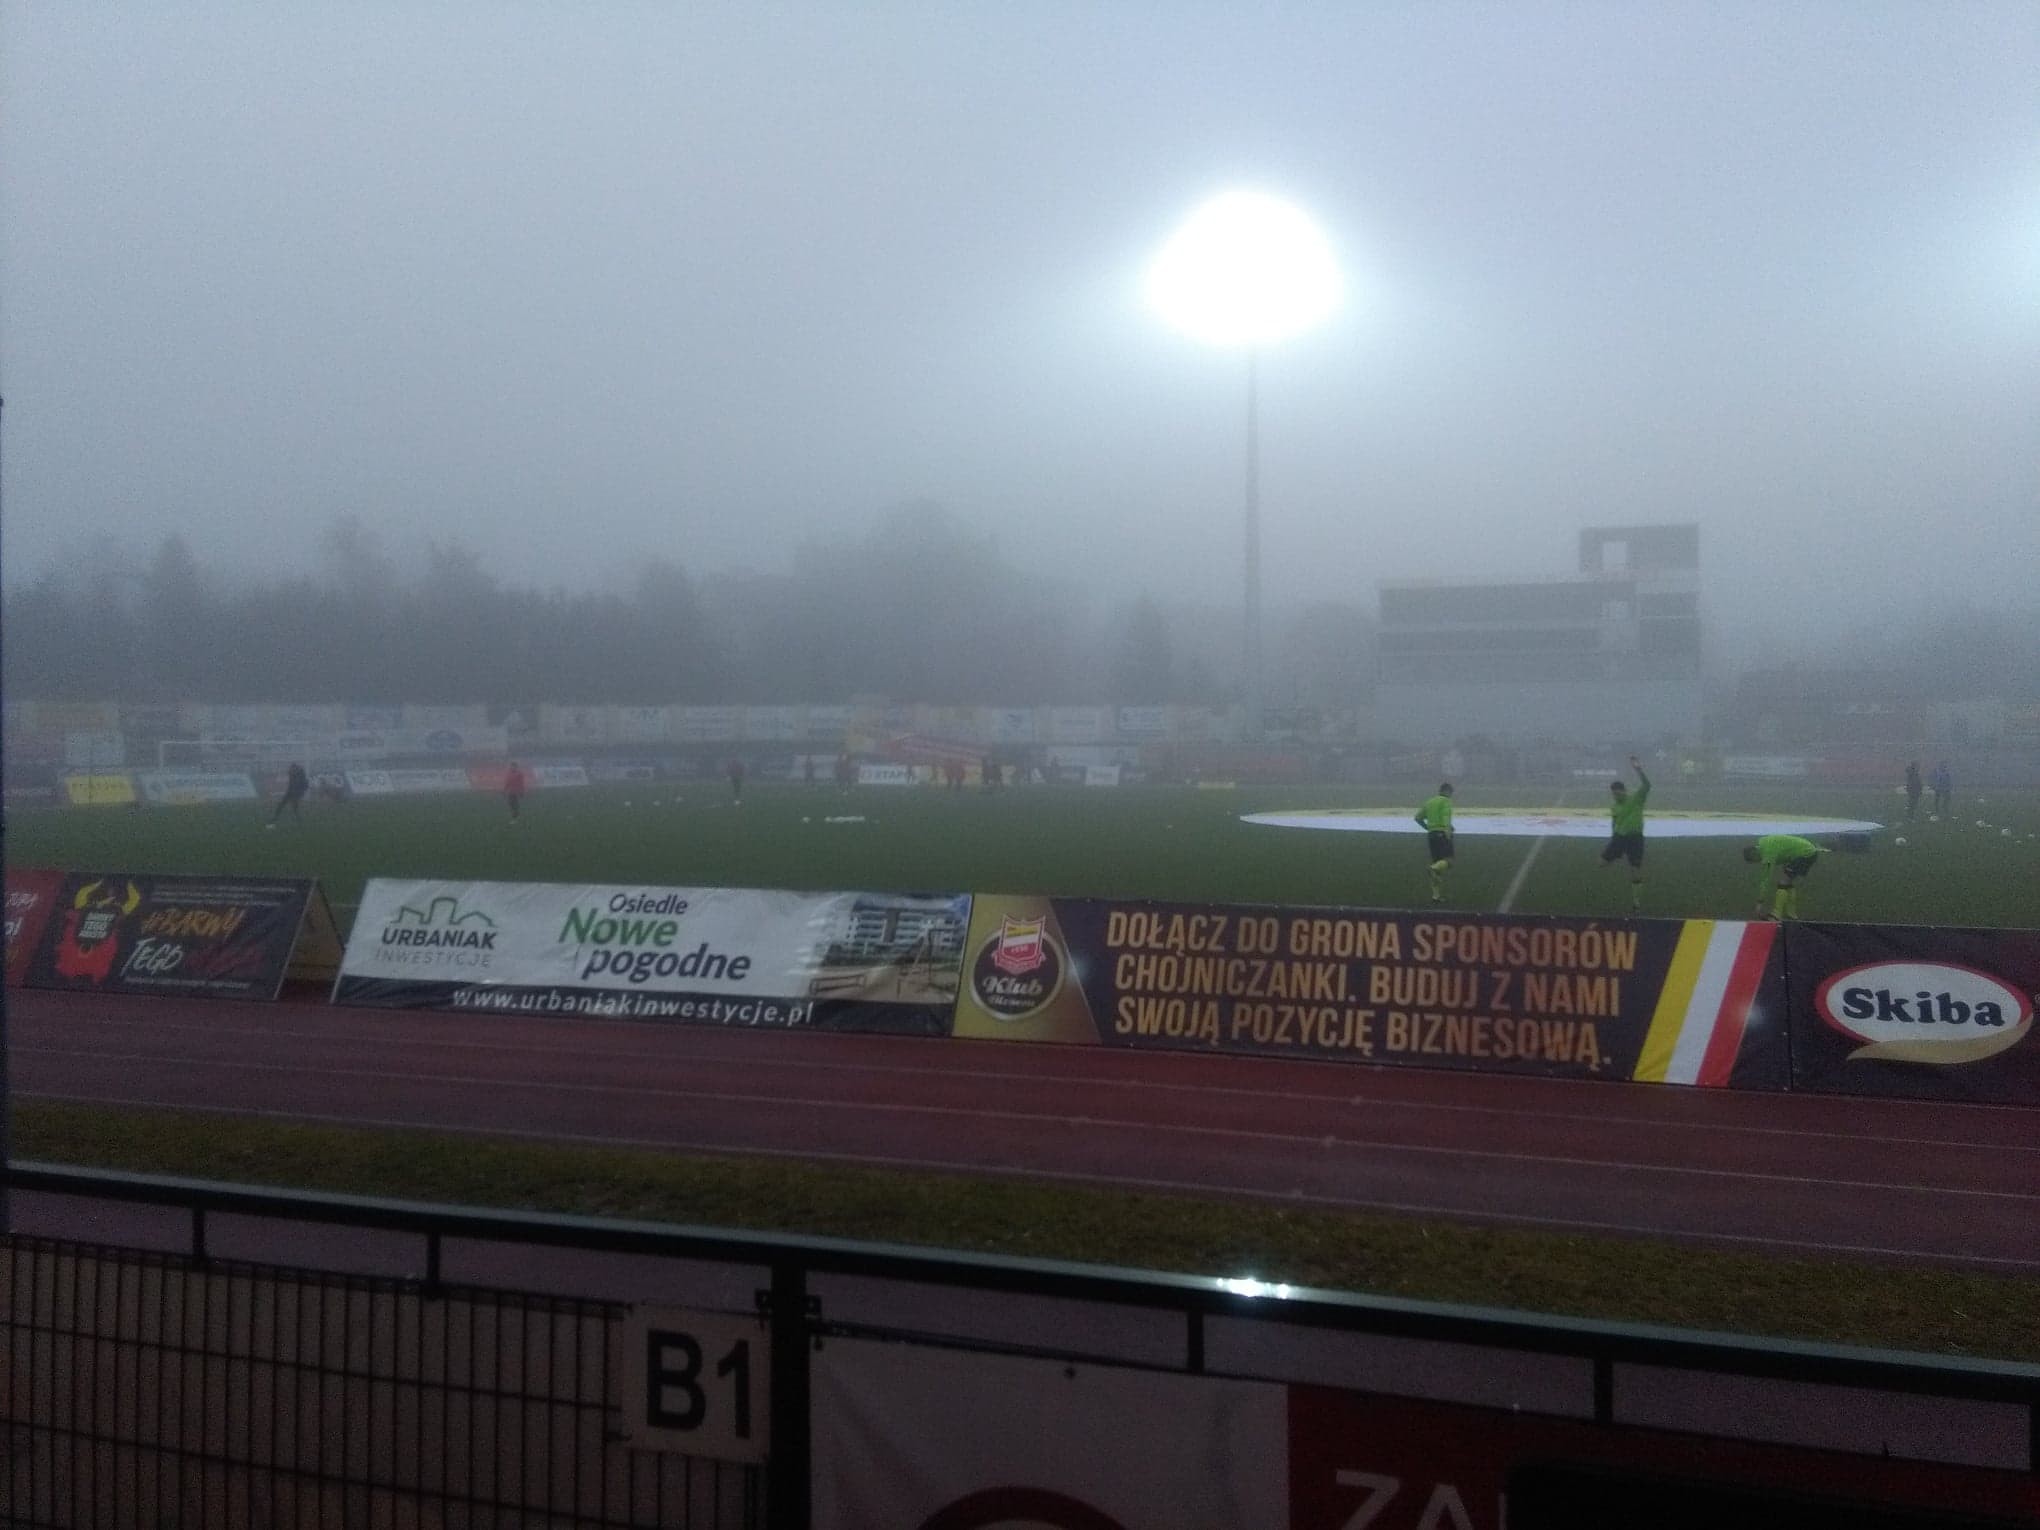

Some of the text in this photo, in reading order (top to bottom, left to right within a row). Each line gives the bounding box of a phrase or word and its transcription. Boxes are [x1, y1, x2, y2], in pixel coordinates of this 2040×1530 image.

[608, 893, 688, 915] Osiedle
[381, 927, 497, 950] URBANIAK
[557, 907, 679, 947] Nowe
[1106, 911, 1638, 971] DOŁĄCZ DO GRONA SPONSORÓW
[375, 949, 491, 968] INWESTYCJE
[581, 942, 751, 984] pogodne
[982, 975, 1043, 995] Klub
[1115, 953, 1620, 1017] CHOJNICZANKI. BUDUJ Z NAMI
[452, 990, 814, 1026] www.urbaniakinwestycje.pl
[1841, 987, 2006, 1027] Skiba
[1114, 996, 1612, 1072] SWOJĄ POZYCJĘ BIZNESOWĄ.
[647, 1328, 751, 1440] B1
